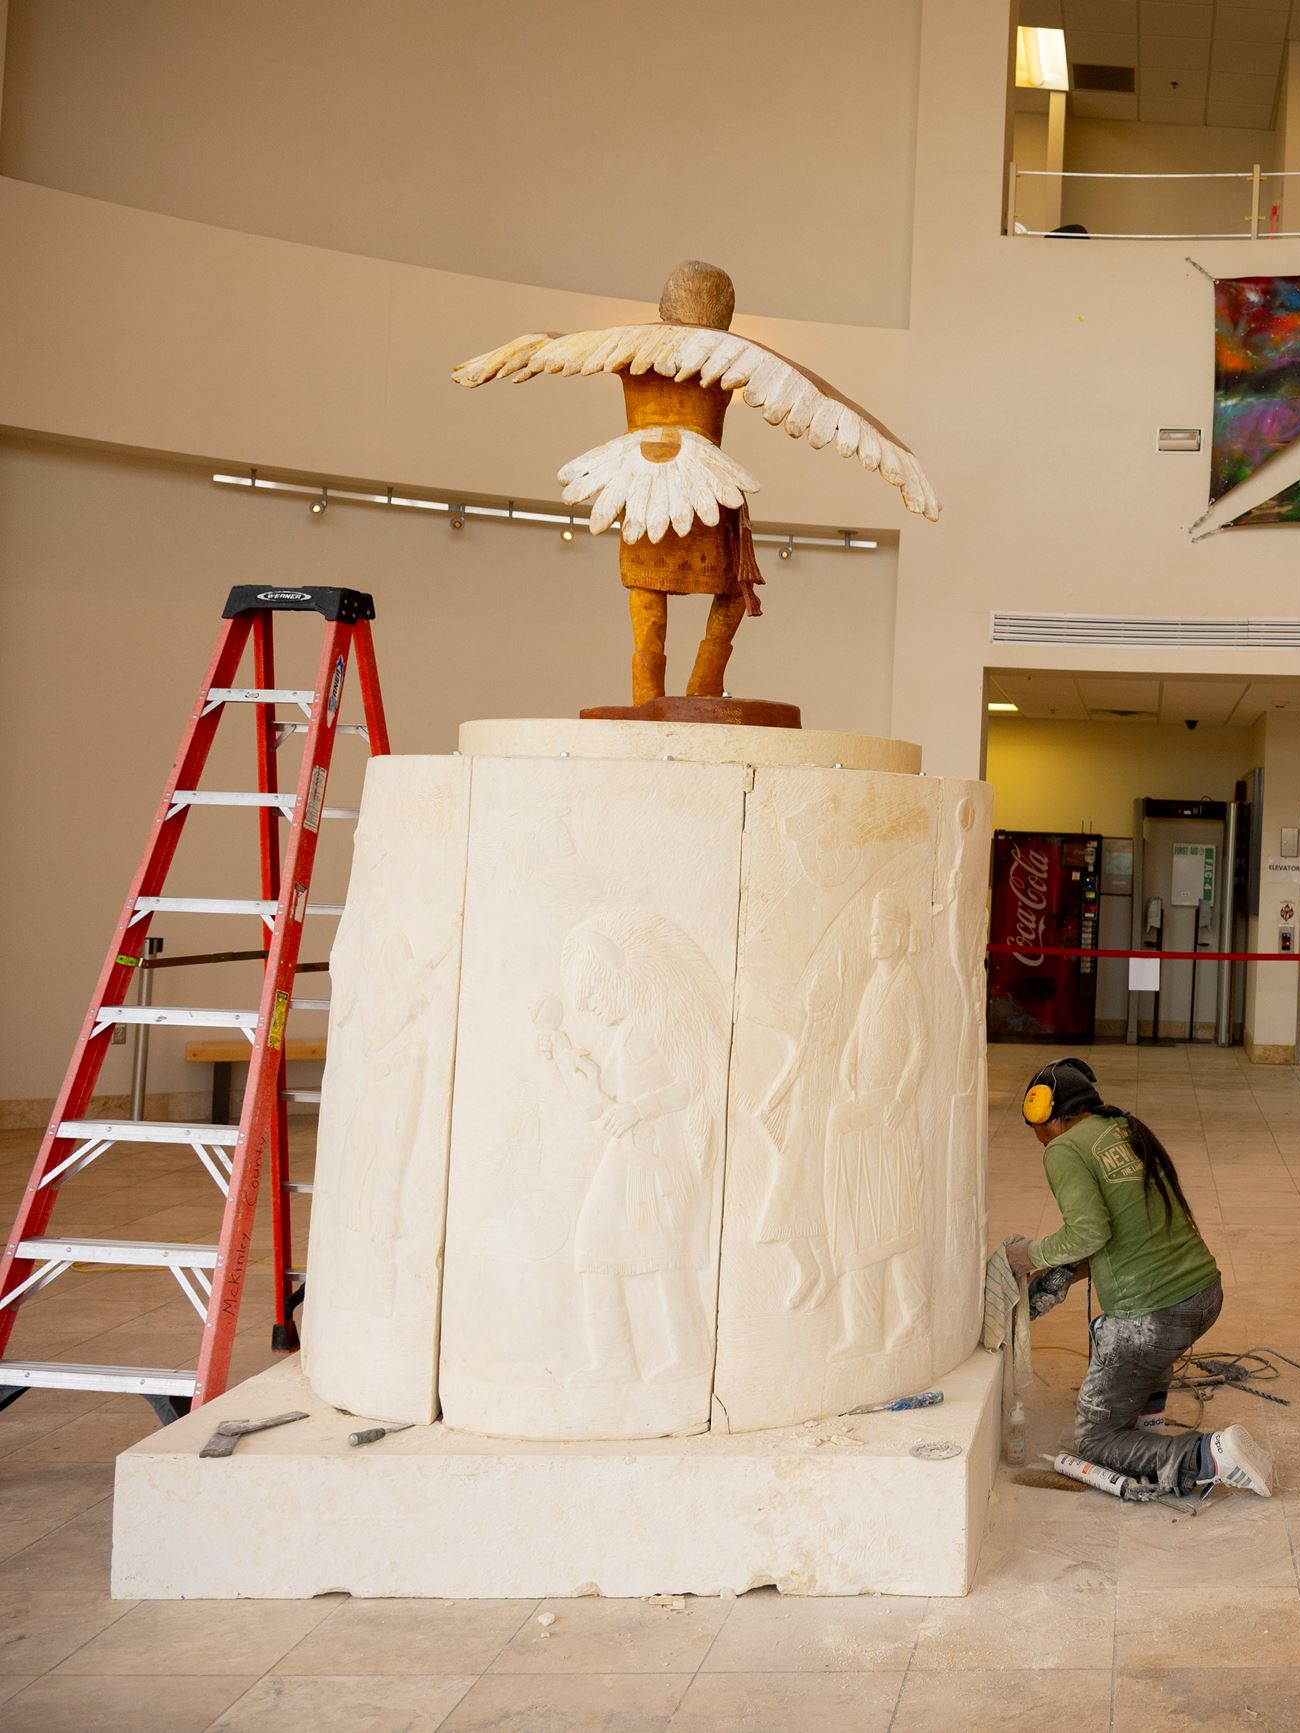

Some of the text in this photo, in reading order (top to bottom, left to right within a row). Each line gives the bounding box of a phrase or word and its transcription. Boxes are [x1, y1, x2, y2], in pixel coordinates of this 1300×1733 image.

[267, 592, 303, 600] WERNER
[1174, 846, 1199, 856] FIRST AID
[1268, 864, 1300, 872] ELEVATOR
[1007, 841, 1049, 967] Coca-Cola
[245, 1136, 268, 1207] County
